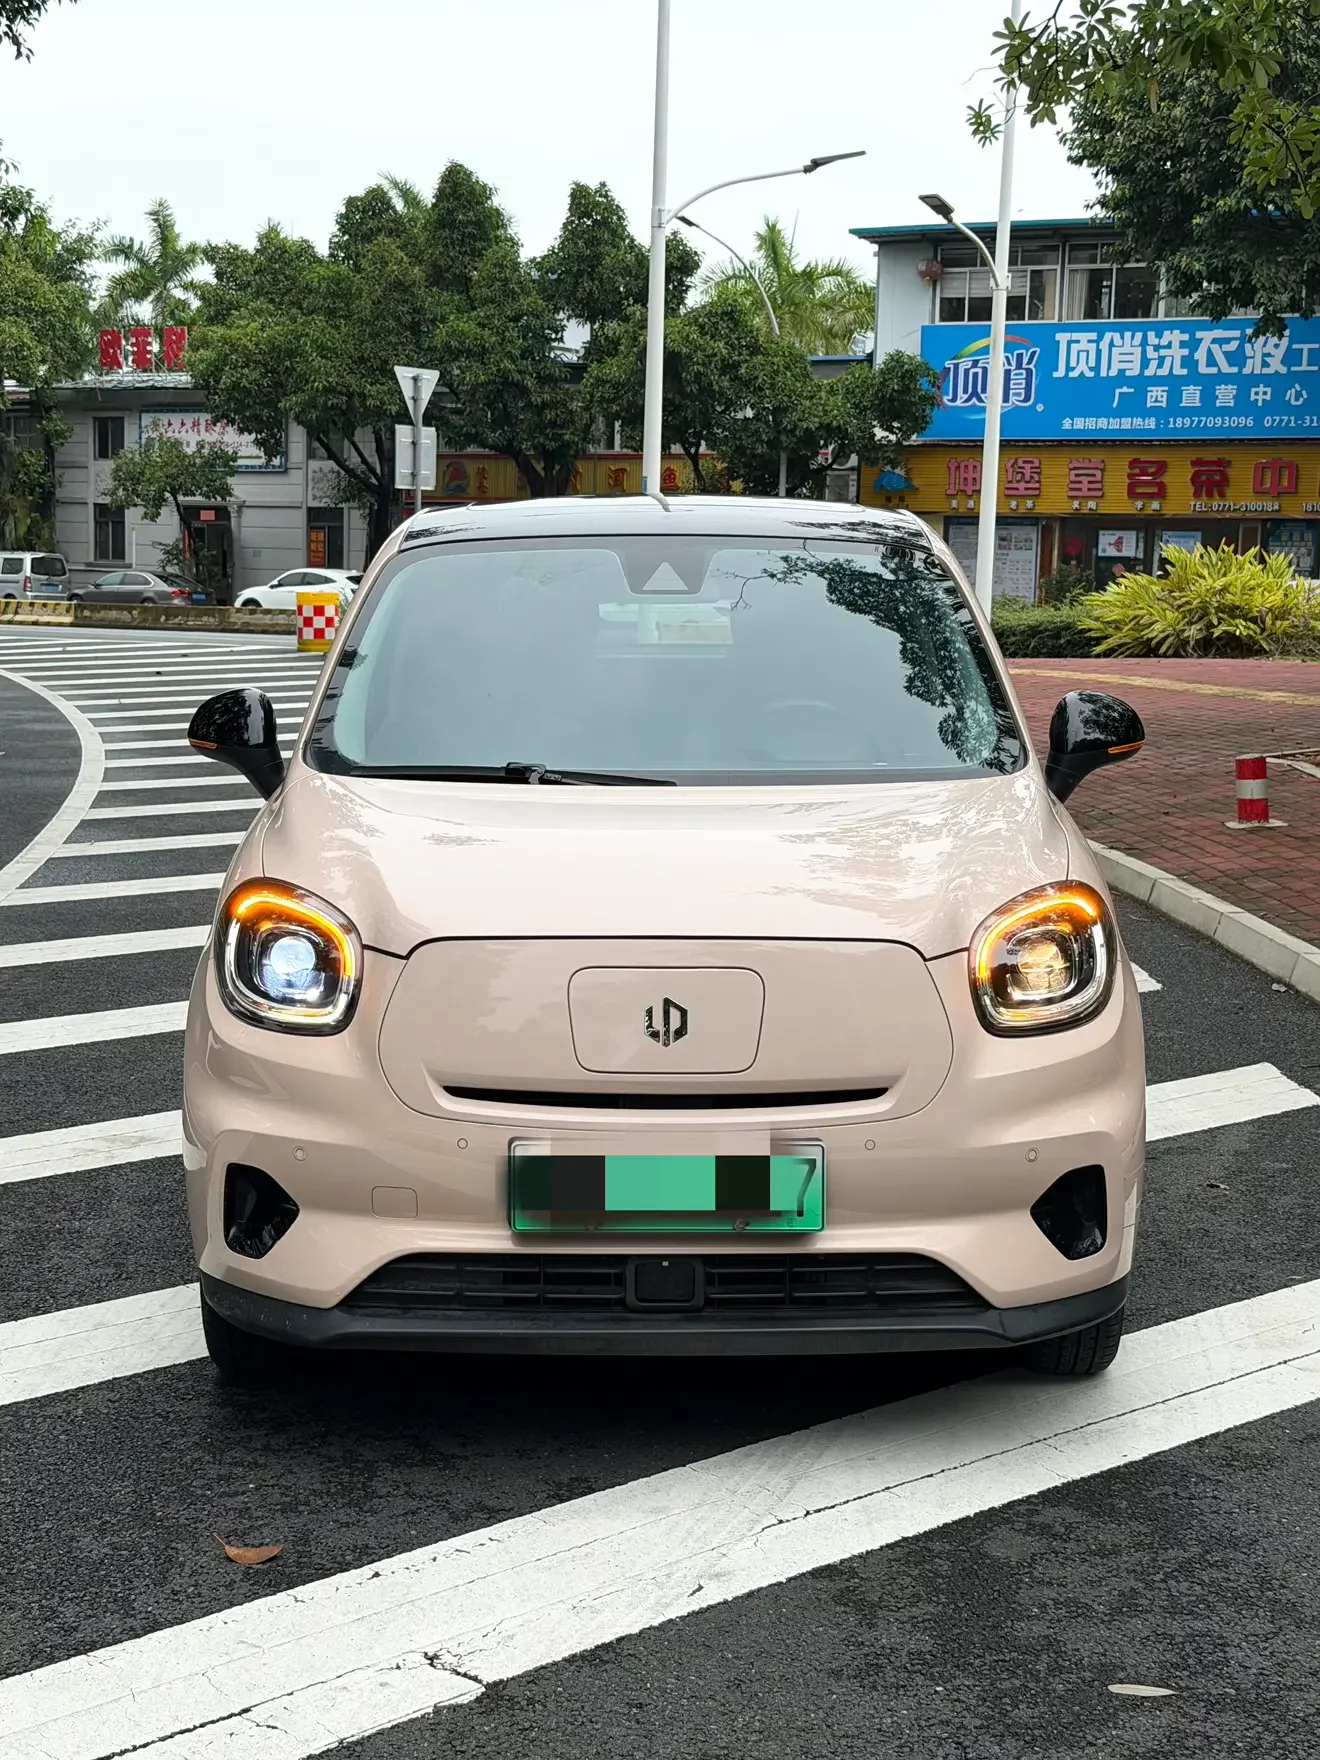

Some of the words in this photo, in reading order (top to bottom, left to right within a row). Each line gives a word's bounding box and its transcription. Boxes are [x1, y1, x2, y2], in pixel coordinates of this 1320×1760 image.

[1112, 384, 1308, 408] 广西直营中心
[1264, 416, 1320, 427] 0771-31
[946, 457, 1320, 498] 坤堡堂名茶中
